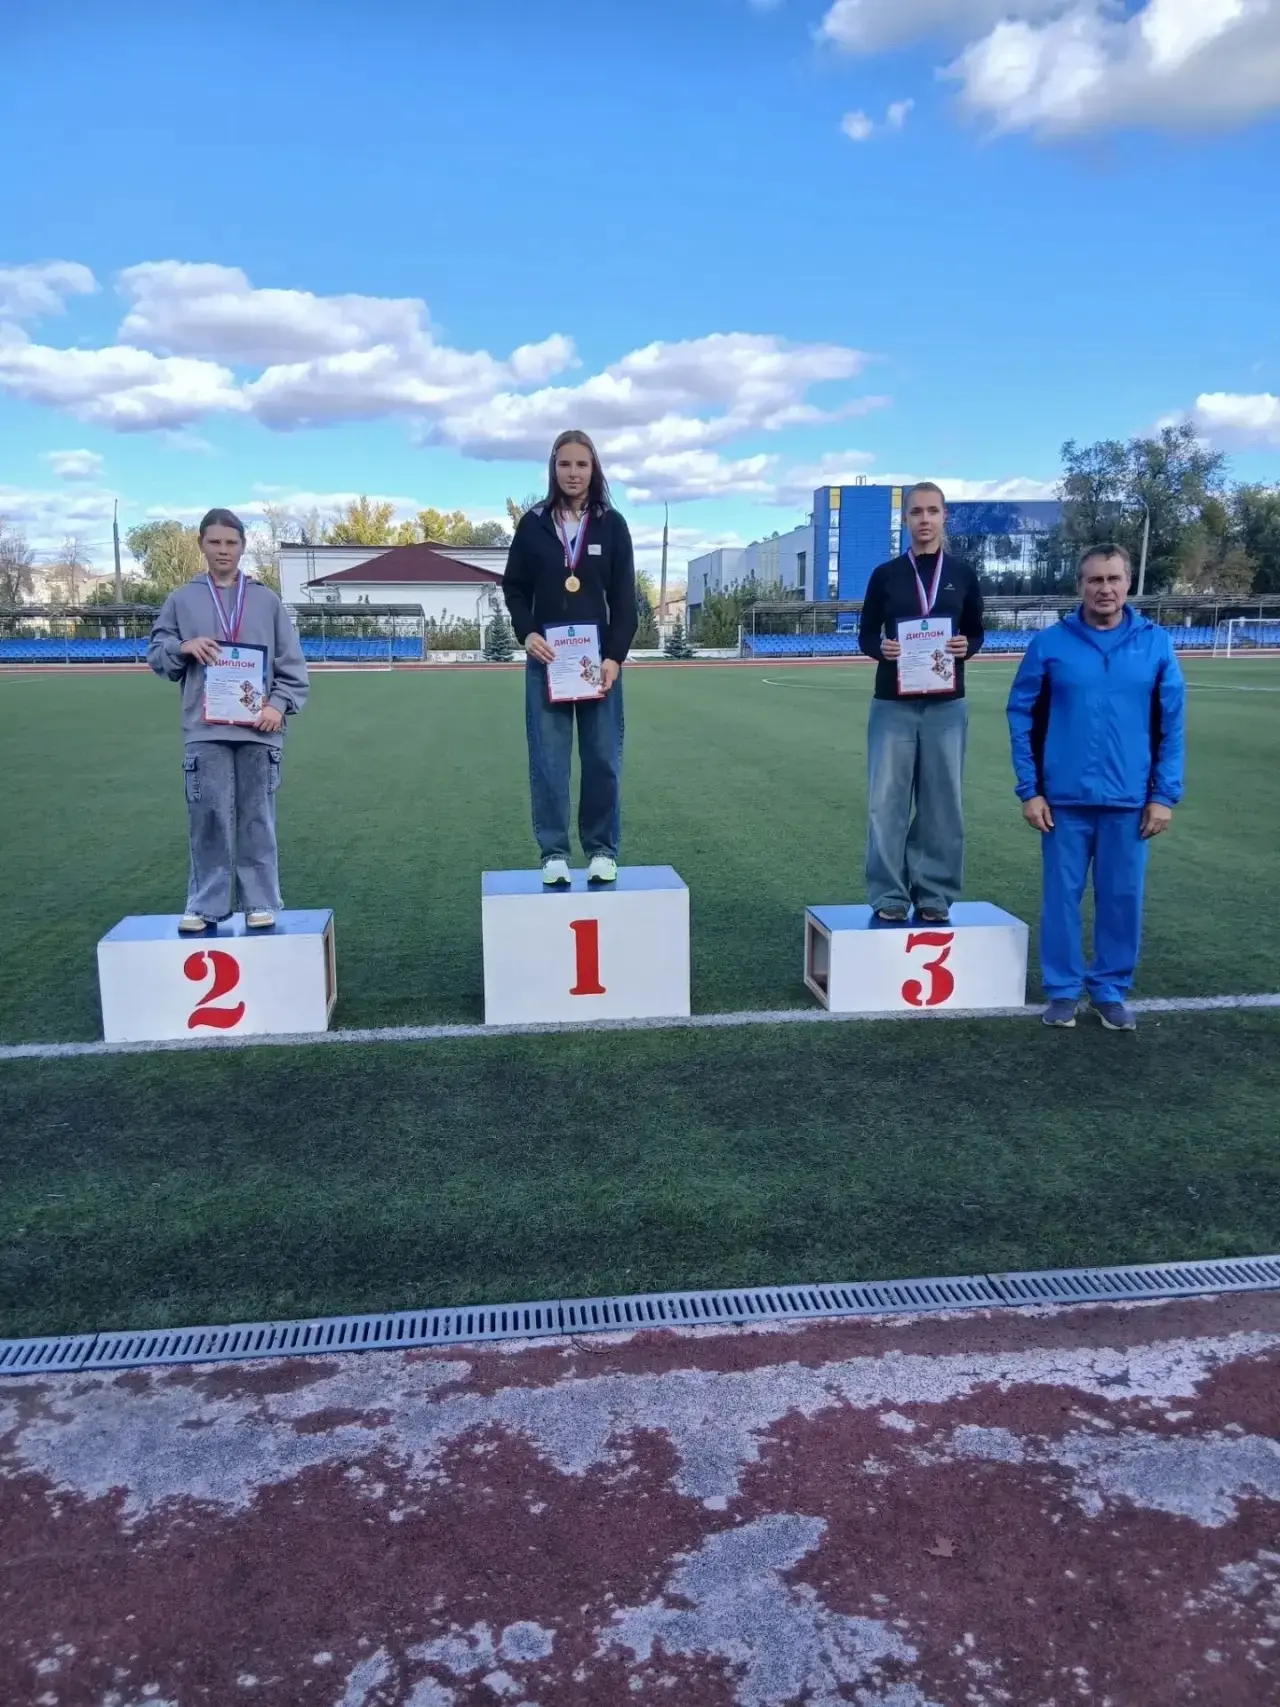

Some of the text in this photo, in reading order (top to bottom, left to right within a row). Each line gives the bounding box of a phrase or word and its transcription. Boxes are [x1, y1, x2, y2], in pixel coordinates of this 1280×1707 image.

[554, 637, 591, 647] ДИПЛОМ
[906, 630, 944, 640] ДИПЛОМ
[184, 951, 246, 1029] 2
[570, 919, 605, 996] 1
[901, 931, 954, 1006] 3
